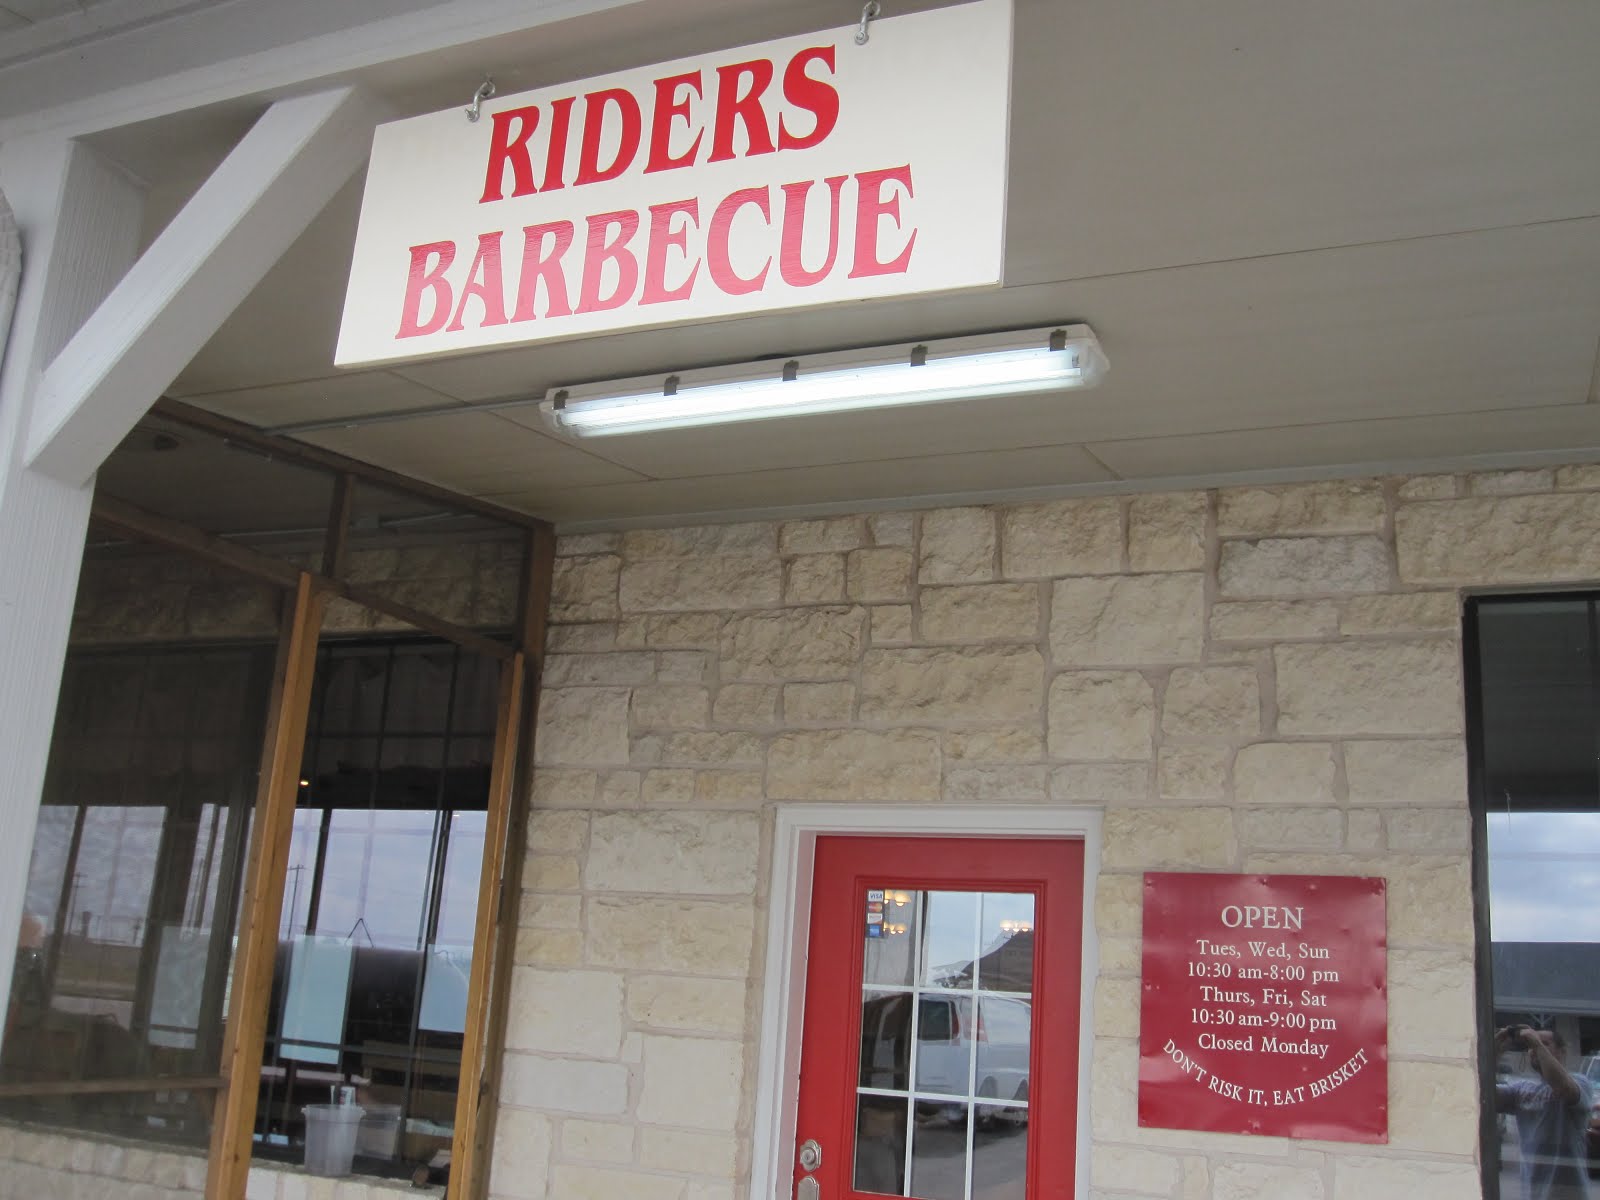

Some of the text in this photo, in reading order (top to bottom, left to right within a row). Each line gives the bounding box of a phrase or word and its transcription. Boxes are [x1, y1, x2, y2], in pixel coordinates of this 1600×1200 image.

[479, 44, 840, 204] RIDERS
[395, 163, 918, 340] BARBECUE
[1221, 905, 1304, 930] OPEN
[1196, 939, 1330, 960] Tues, Wed, Sun
[1188, 962, 1340, 985] 10:30 am-8:00 pm
[1200, 985, 1327, 1008] Thurs, Fri, Sat
[1191, 1008, 1337, 1032] 10:30 am-9:00 pm
[1198, 1033, 1329, 1060] Closed Monday
[1163, 1039, 1370, 1106] DON'T RISK IT, EAT BRISKET
